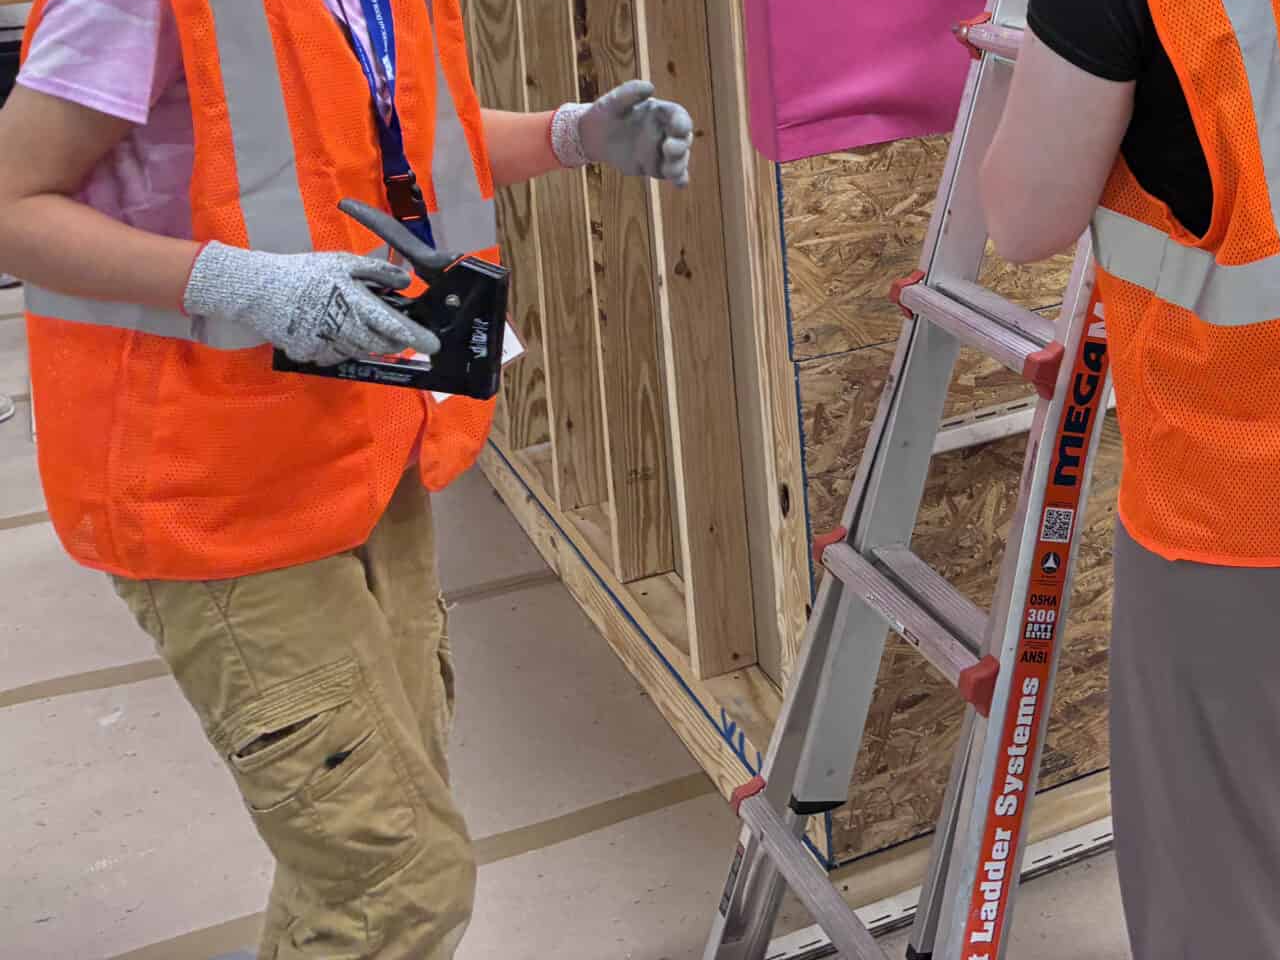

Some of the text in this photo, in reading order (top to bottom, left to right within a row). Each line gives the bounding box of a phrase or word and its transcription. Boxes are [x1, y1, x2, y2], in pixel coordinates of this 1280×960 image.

[1030, 594, 1057, 607] OSHA
[1027, 608, 1056, 623] 300
[1020, 651, 1048, 664] ANSI
[971, 828, 1013, 944] Ladder
[995, 676, 1040, 817] Systems
